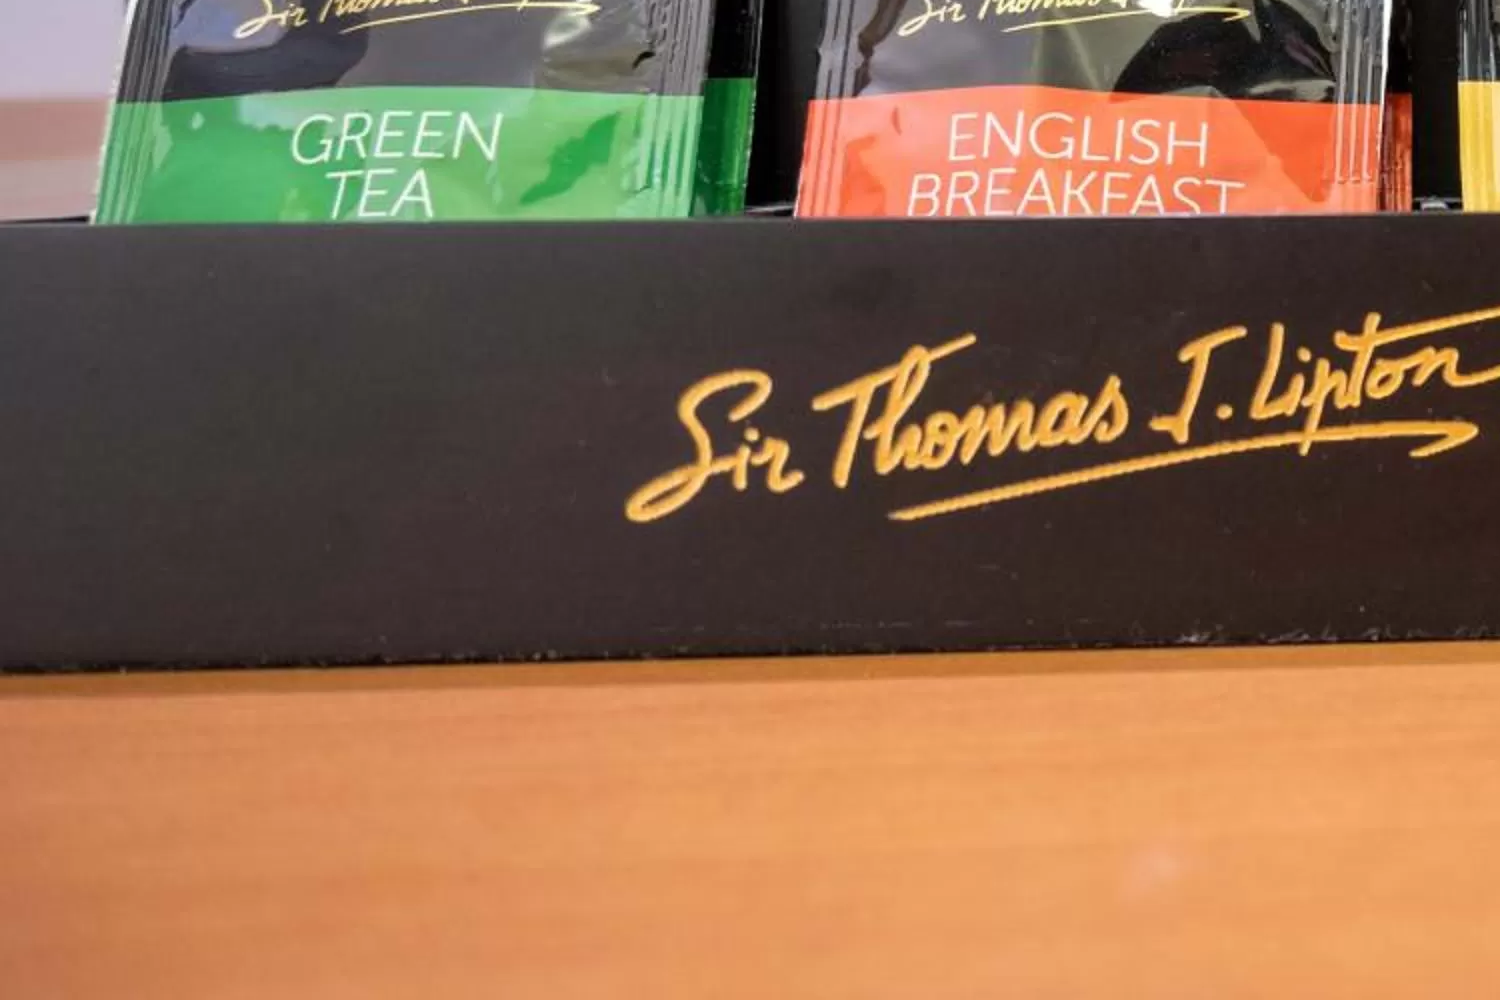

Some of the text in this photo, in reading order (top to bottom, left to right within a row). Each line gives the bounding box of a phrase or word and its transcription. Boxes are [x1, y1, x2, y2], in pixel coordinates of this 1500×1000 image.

[290, 108, 505, 166] GREEN
[947, 110, 1211, 168] ENGLISH
[324, 168, 435, 221] TEA
[906, 167, 1246, 217] BREAKFAST
[626, 369, 805, 523] Sir
[811, 332, 1131, 491] Thomas
